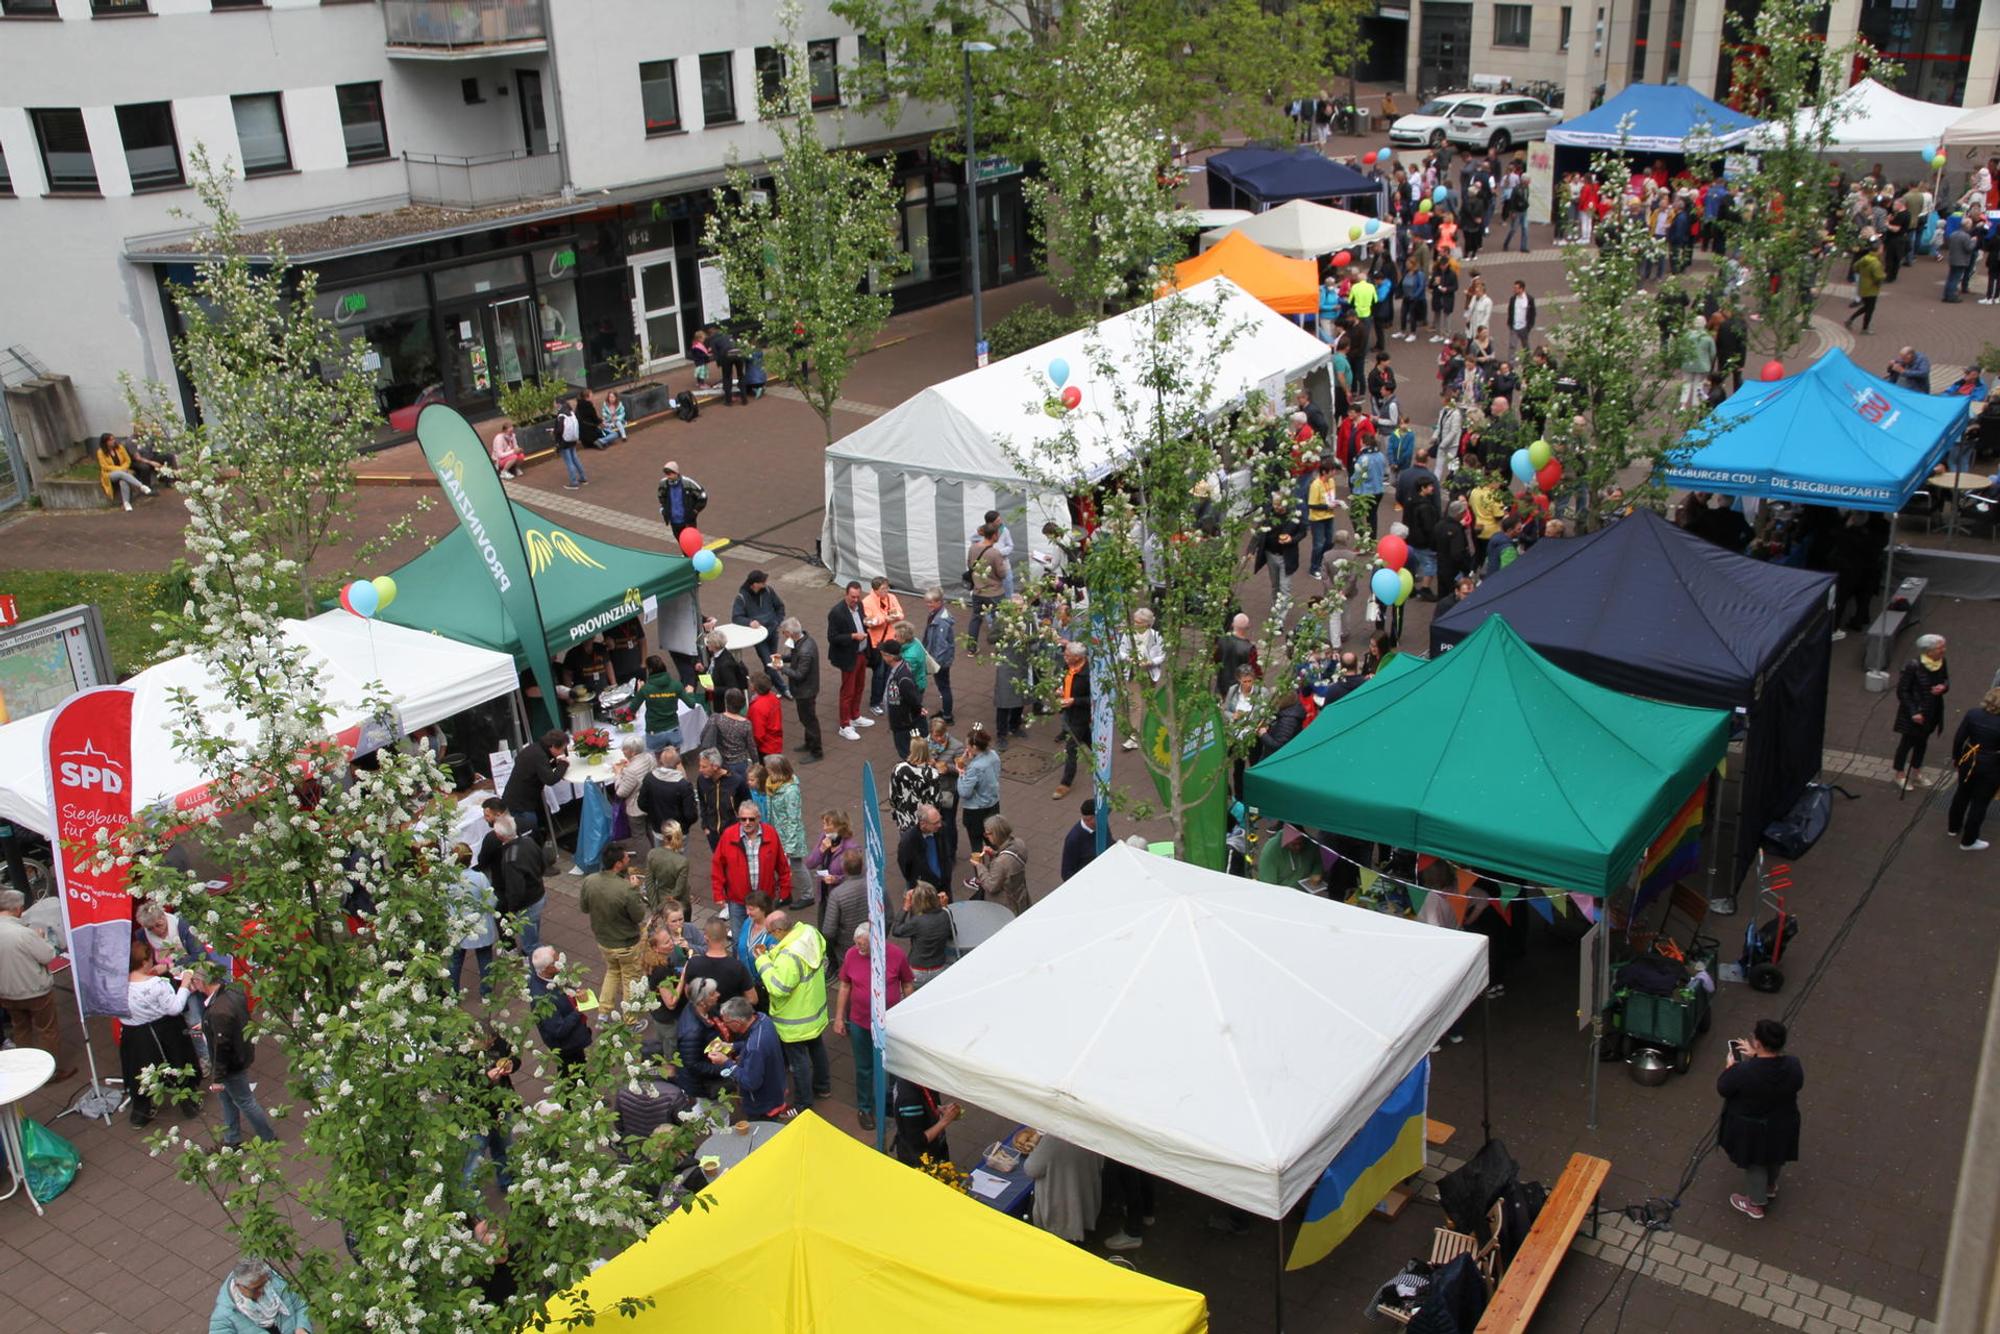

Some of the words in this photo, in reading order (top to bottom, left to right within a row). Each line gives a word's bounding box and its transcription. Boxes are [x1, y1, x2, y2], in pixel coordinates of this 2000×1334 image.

[1731, 473, 1757, 485] CDU
[1771, 477, 1790, 487] DIE
[570, 601, 639, 640] PROVINZIAL
[60, 761, 123, 794] SPD
